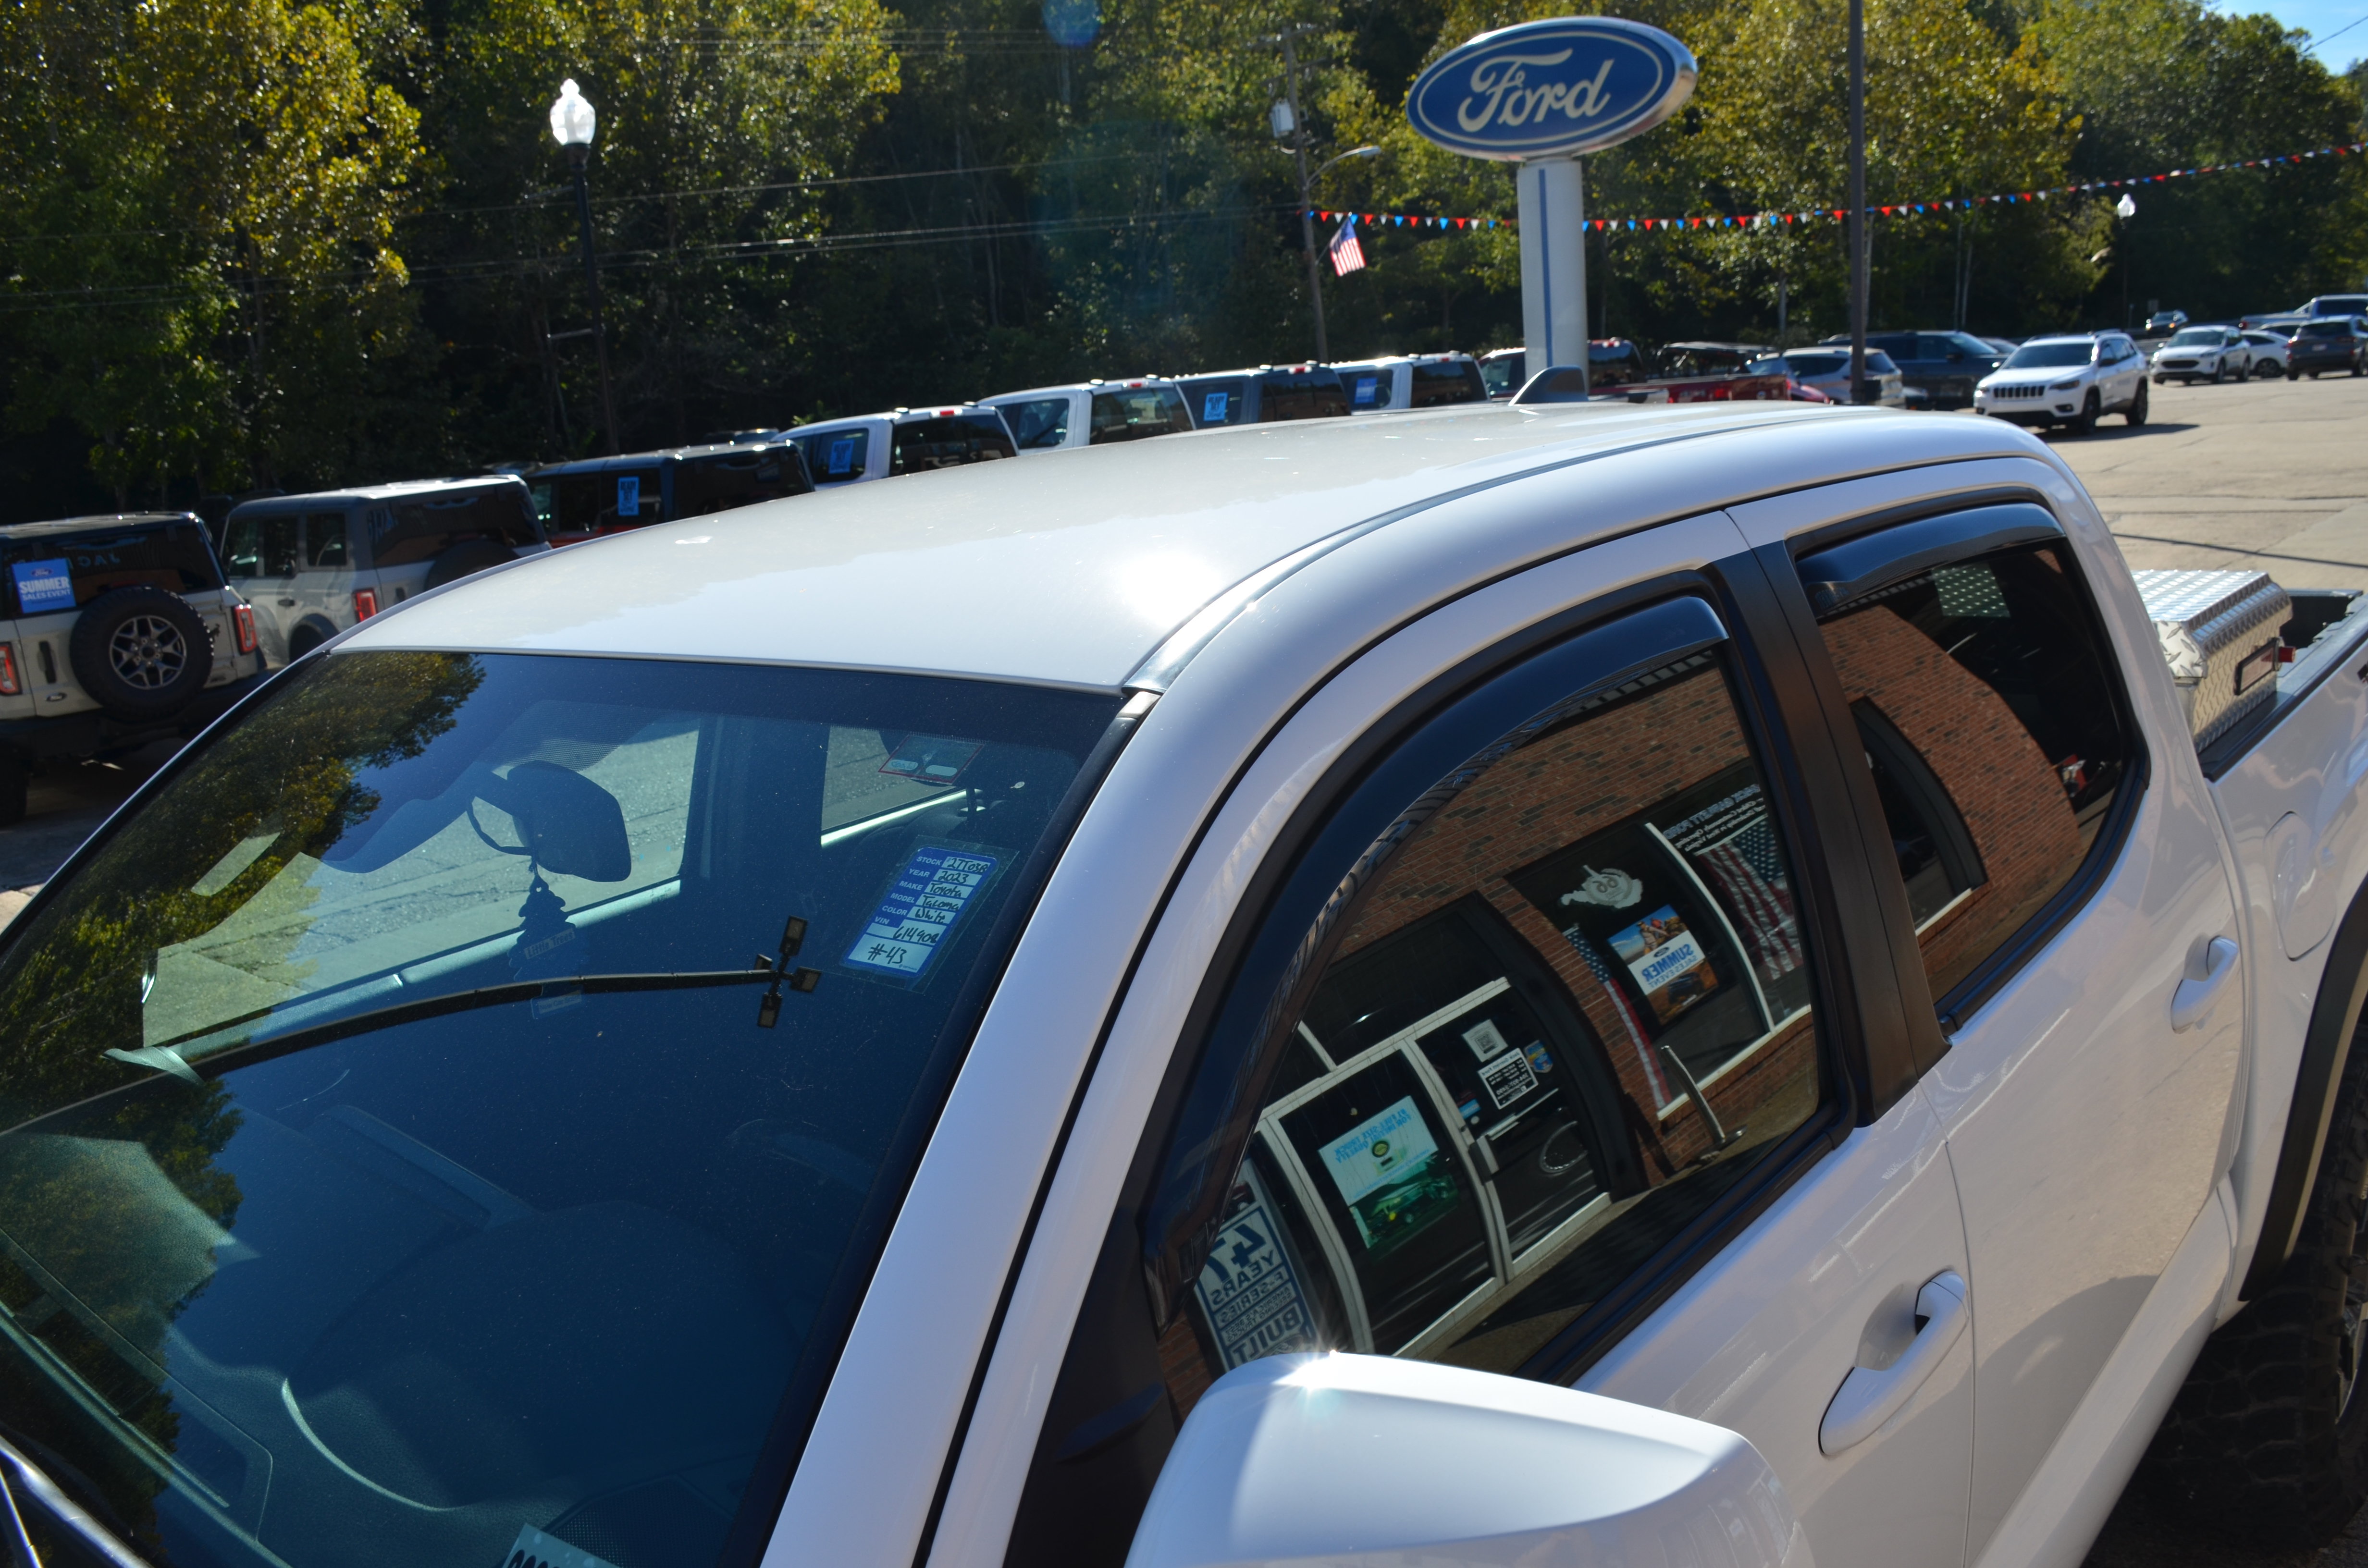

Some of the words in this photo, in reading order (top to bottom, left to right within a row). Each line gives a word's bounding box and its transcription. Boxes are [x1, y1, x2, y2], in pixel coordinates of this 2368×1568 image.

[1457, 49, 1614, 132] Ford
[19, 576, 70, 594] SUMMER
[23, 592, 47, 601] SALES
[48, 589, 71, 598] EVENT
[916, 856, 943, 866] STOCK
[909, 869, 930, 878] YEAR
[938, 870, 969, 884] 2023
[899, 881, 924, 891] MAKE
[929, 882, 962, 897] Toyota
[890, 893, 915, 903] MODEL
[922, 894, 959, 911] Tacoma
[875, 916, 890, 925] VIN
[882, 905, 908, 916] COLOR
[914, 907, 946, 924] White
[893, 926, 939, 944] 614908
[867, 943, 907, 964] #43
